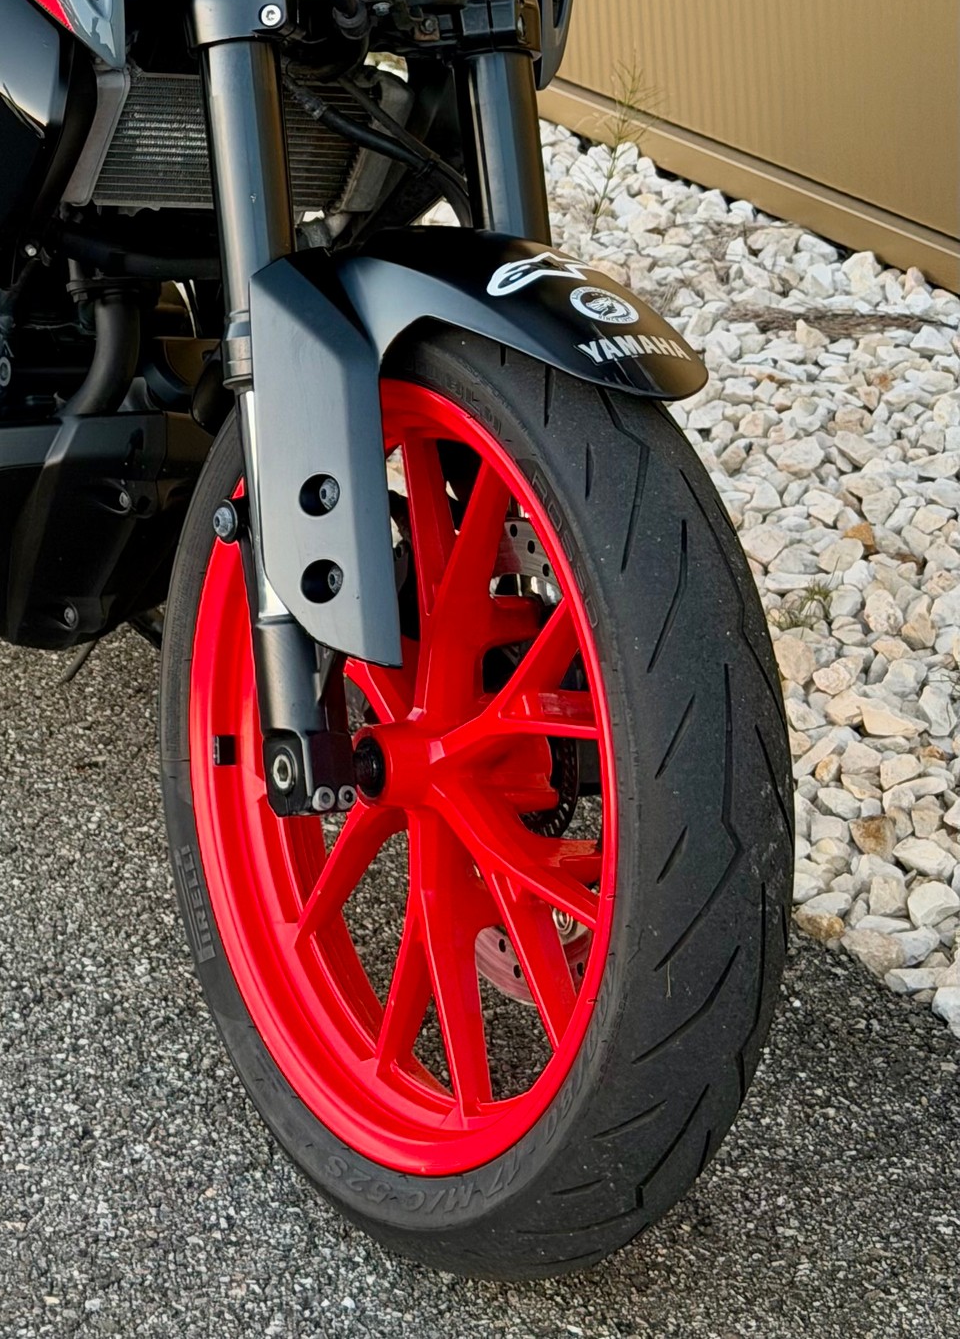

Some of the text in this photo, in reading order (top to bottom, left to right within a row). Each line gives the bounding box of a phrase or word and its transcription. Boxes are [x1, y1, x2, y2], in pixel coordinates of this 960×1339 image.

[579, 335, 692, 363] YAMAHA
[529, 469, 600, 630] ROSSO
[173, 844, 217, 964] PIRELLI
